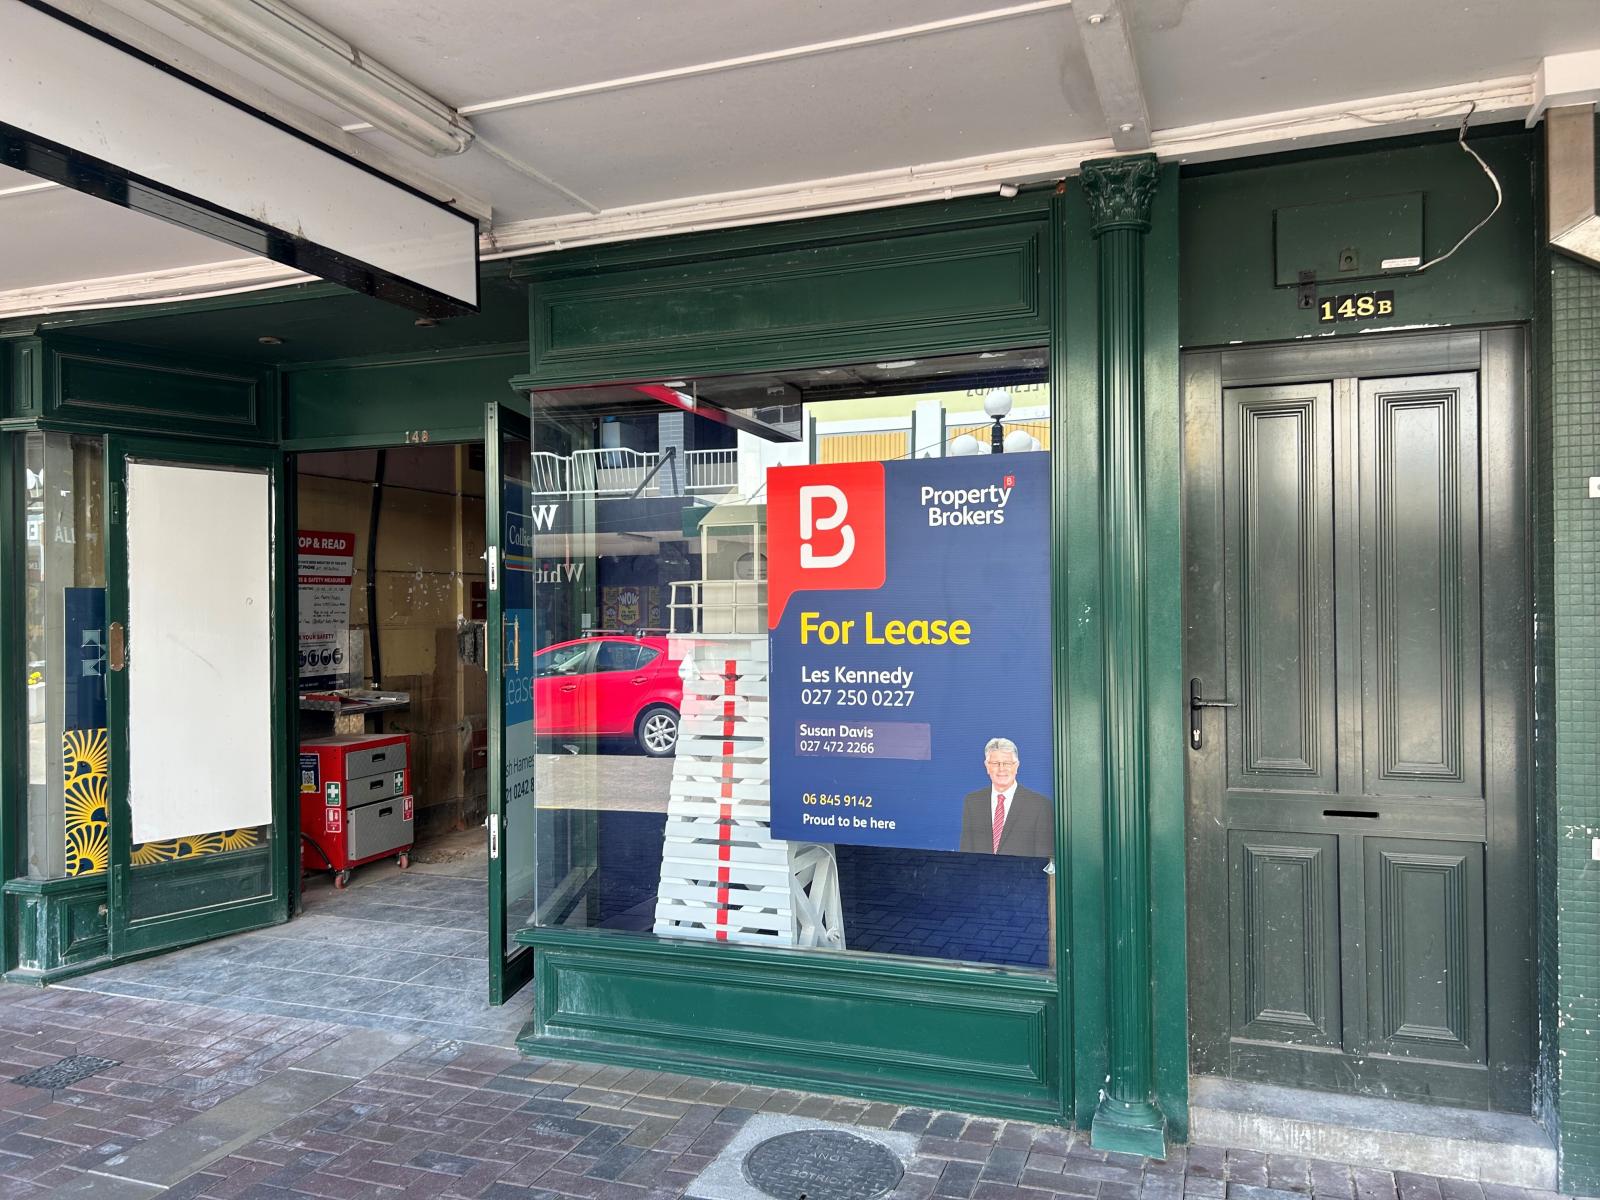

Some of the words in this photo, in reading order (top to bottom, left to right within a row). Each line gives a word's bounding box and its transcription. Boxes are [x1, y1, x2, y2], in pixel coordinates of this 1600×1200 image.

[1321, 296, 1392, 320] 148B
[404, 430, 429, 444] 148
[921, 484, 1011, 509] Property
[928, 506, 1005, 527] Brokers
[298, 537, 312, 548] OP
[322, 539, 346, 550] READ
[800, 611, 855, 645] For
[865, 611, 971, 645] Lease
[801, 665, 830, 684] Les
[834, 666, 914, 689] Kennedy
[505, 675, 534, 707] ease
[801, 689, 832, 705] 027
[836, 690, 868, 706] 250
[871, 690, 915, 707] 0227
[800, 723, 836, 737] Susan
[839, 725, 874, 738] Davis
[800, 740, 821, 752] 027
[823, 741, 844, 753] 472
[846, 742, 875, 754] 2266
[802, 793, 817, 805] 06
[819, 794, 841, 807] 845
[843, 795, 873, 808] 9142
[803, 813, 835, 826] Proud
[838, 815, 851, 827] to
[853, 816, 867, 828] be
[870, 817, 896, 830] here
